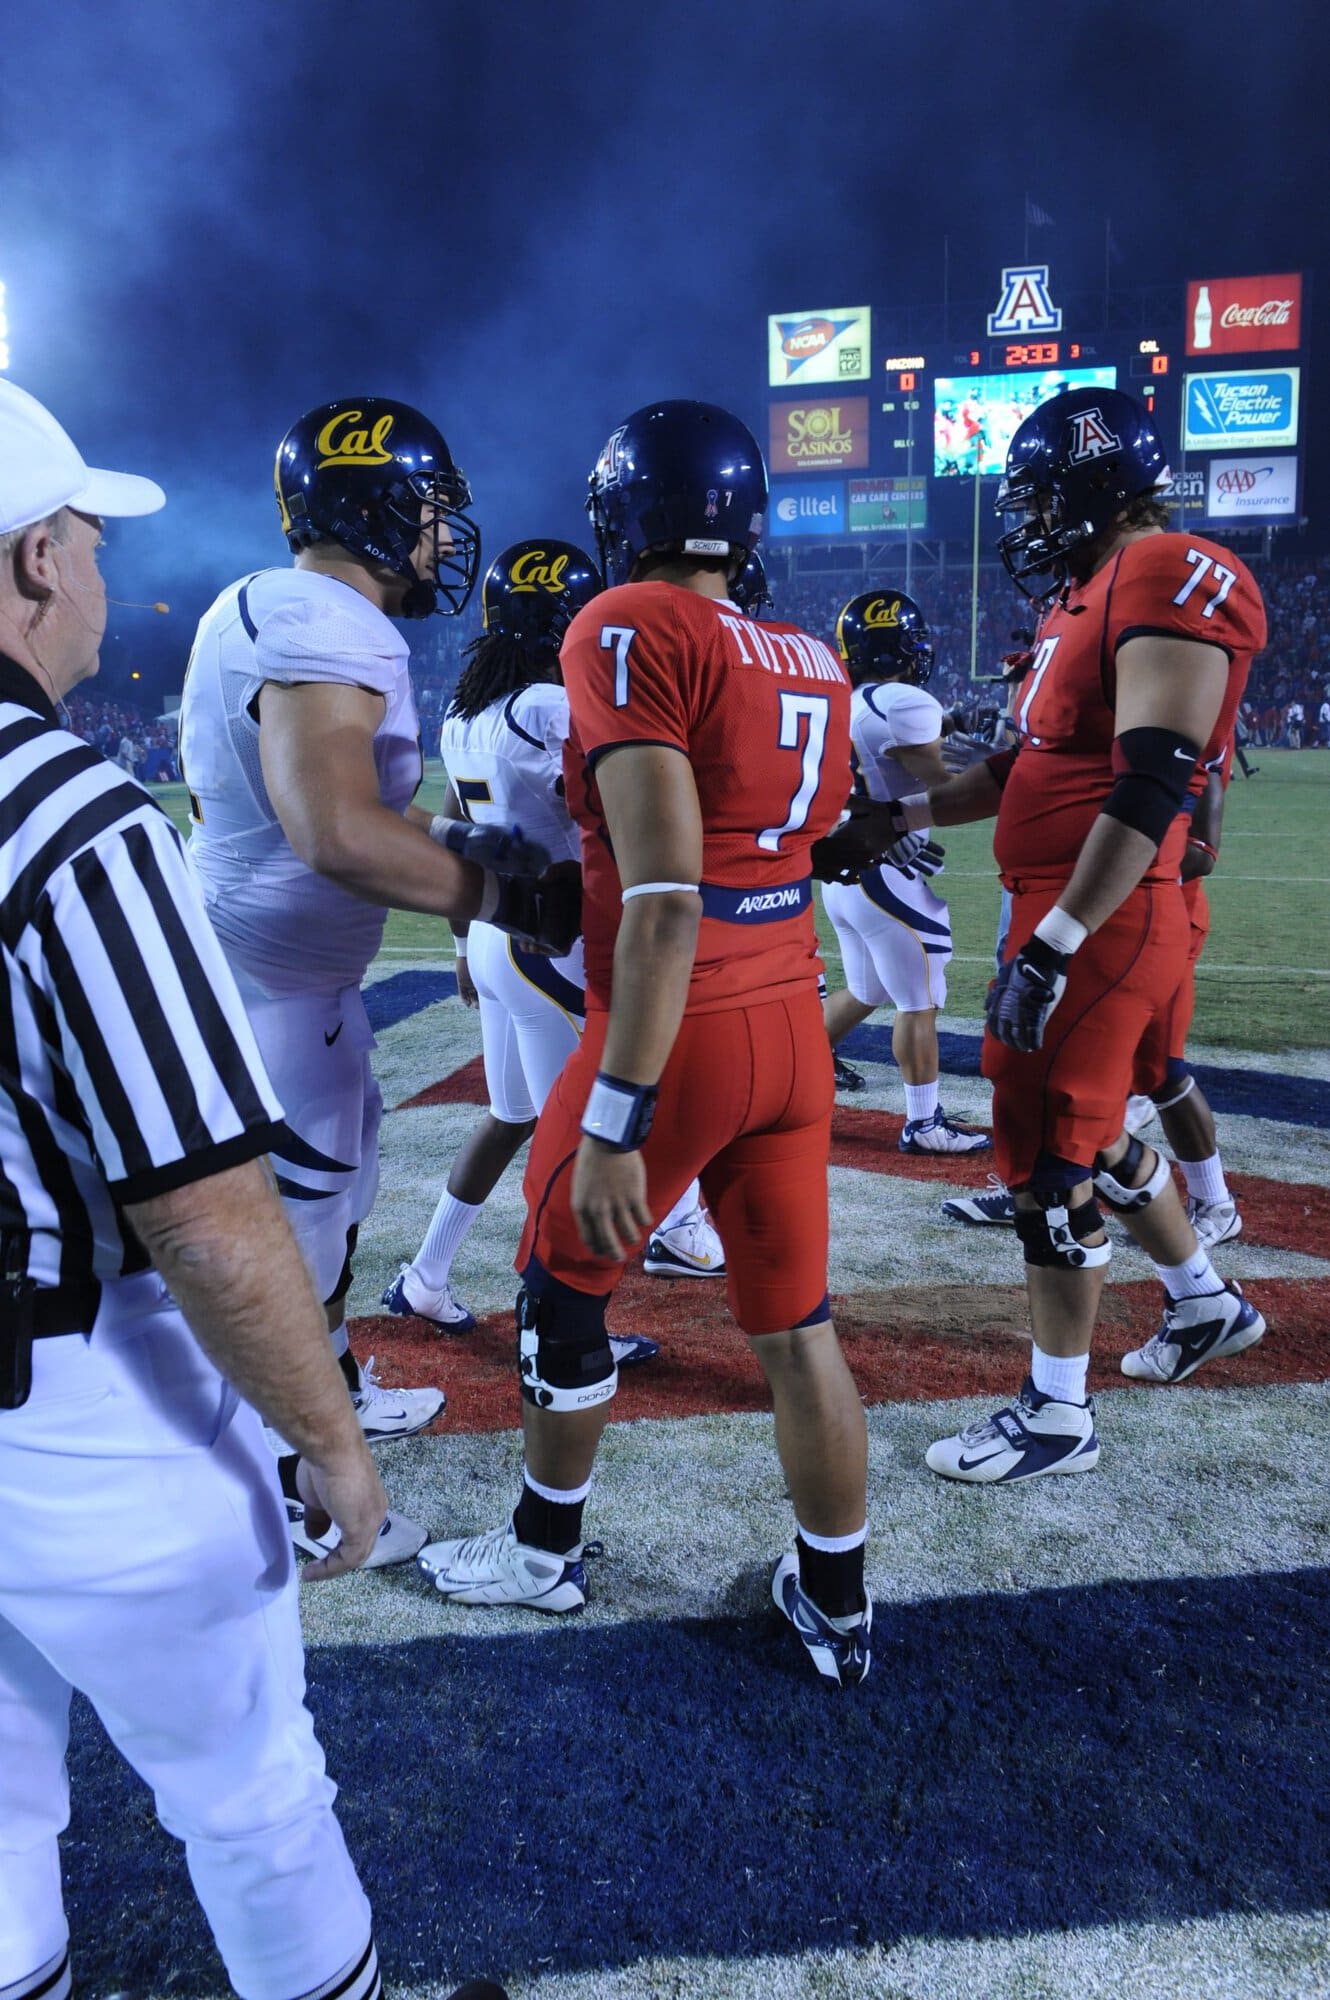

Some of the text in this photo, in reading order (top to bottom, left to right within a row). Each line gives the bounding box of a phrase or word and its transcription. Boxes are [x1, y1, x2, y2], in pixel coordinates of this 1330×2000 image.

[987, 265, 1062, 336] A
[1220, 300, 1294, 328] Coca-Cola
[790, 334, 827, 349] NCAA
[1071, 345, 1080, 358] 3
[1139, 341, 1159, 353] CAL
[886, 357, 925, 371] ARIZONA
[970, 352, 979, 365] 3
[1005, 344, 1058, 366] 2:33
[1152, 356, 1168, 374] 0
[900, 373, 914, 391] 0
[1214, 383, 1268, 398] Tucson
[1148, 397, 1154, 411] 1
[1219, 396, 1282, 412] Electric
[788, 407, 852, 442] SOL
[1225, 411, 1281, 426] Power
[318, 411, 394, 470] Cal
[1067, 408, 1122, 465] A
[787, 440, 852, 457] CASINOS
[1172, 471, 1203, 480] ucson
[1217, 470, 1255, 493] AAA
[725, 491, 732, 506] 7
[787, 495, 838, 517] alltel
[1236, 496, 1290, 506] Insurance
[510, 551, 568, 593] Cal
[1171, 547, 1237, 619] 77
[864, 599, 900, 631] Cal
[601, 625, 637, 709] 7
[1020, 634, 1061, 746] 7
[755, 689, 829, 852] 7
[736, 889, 800, 915] ARIZONA
